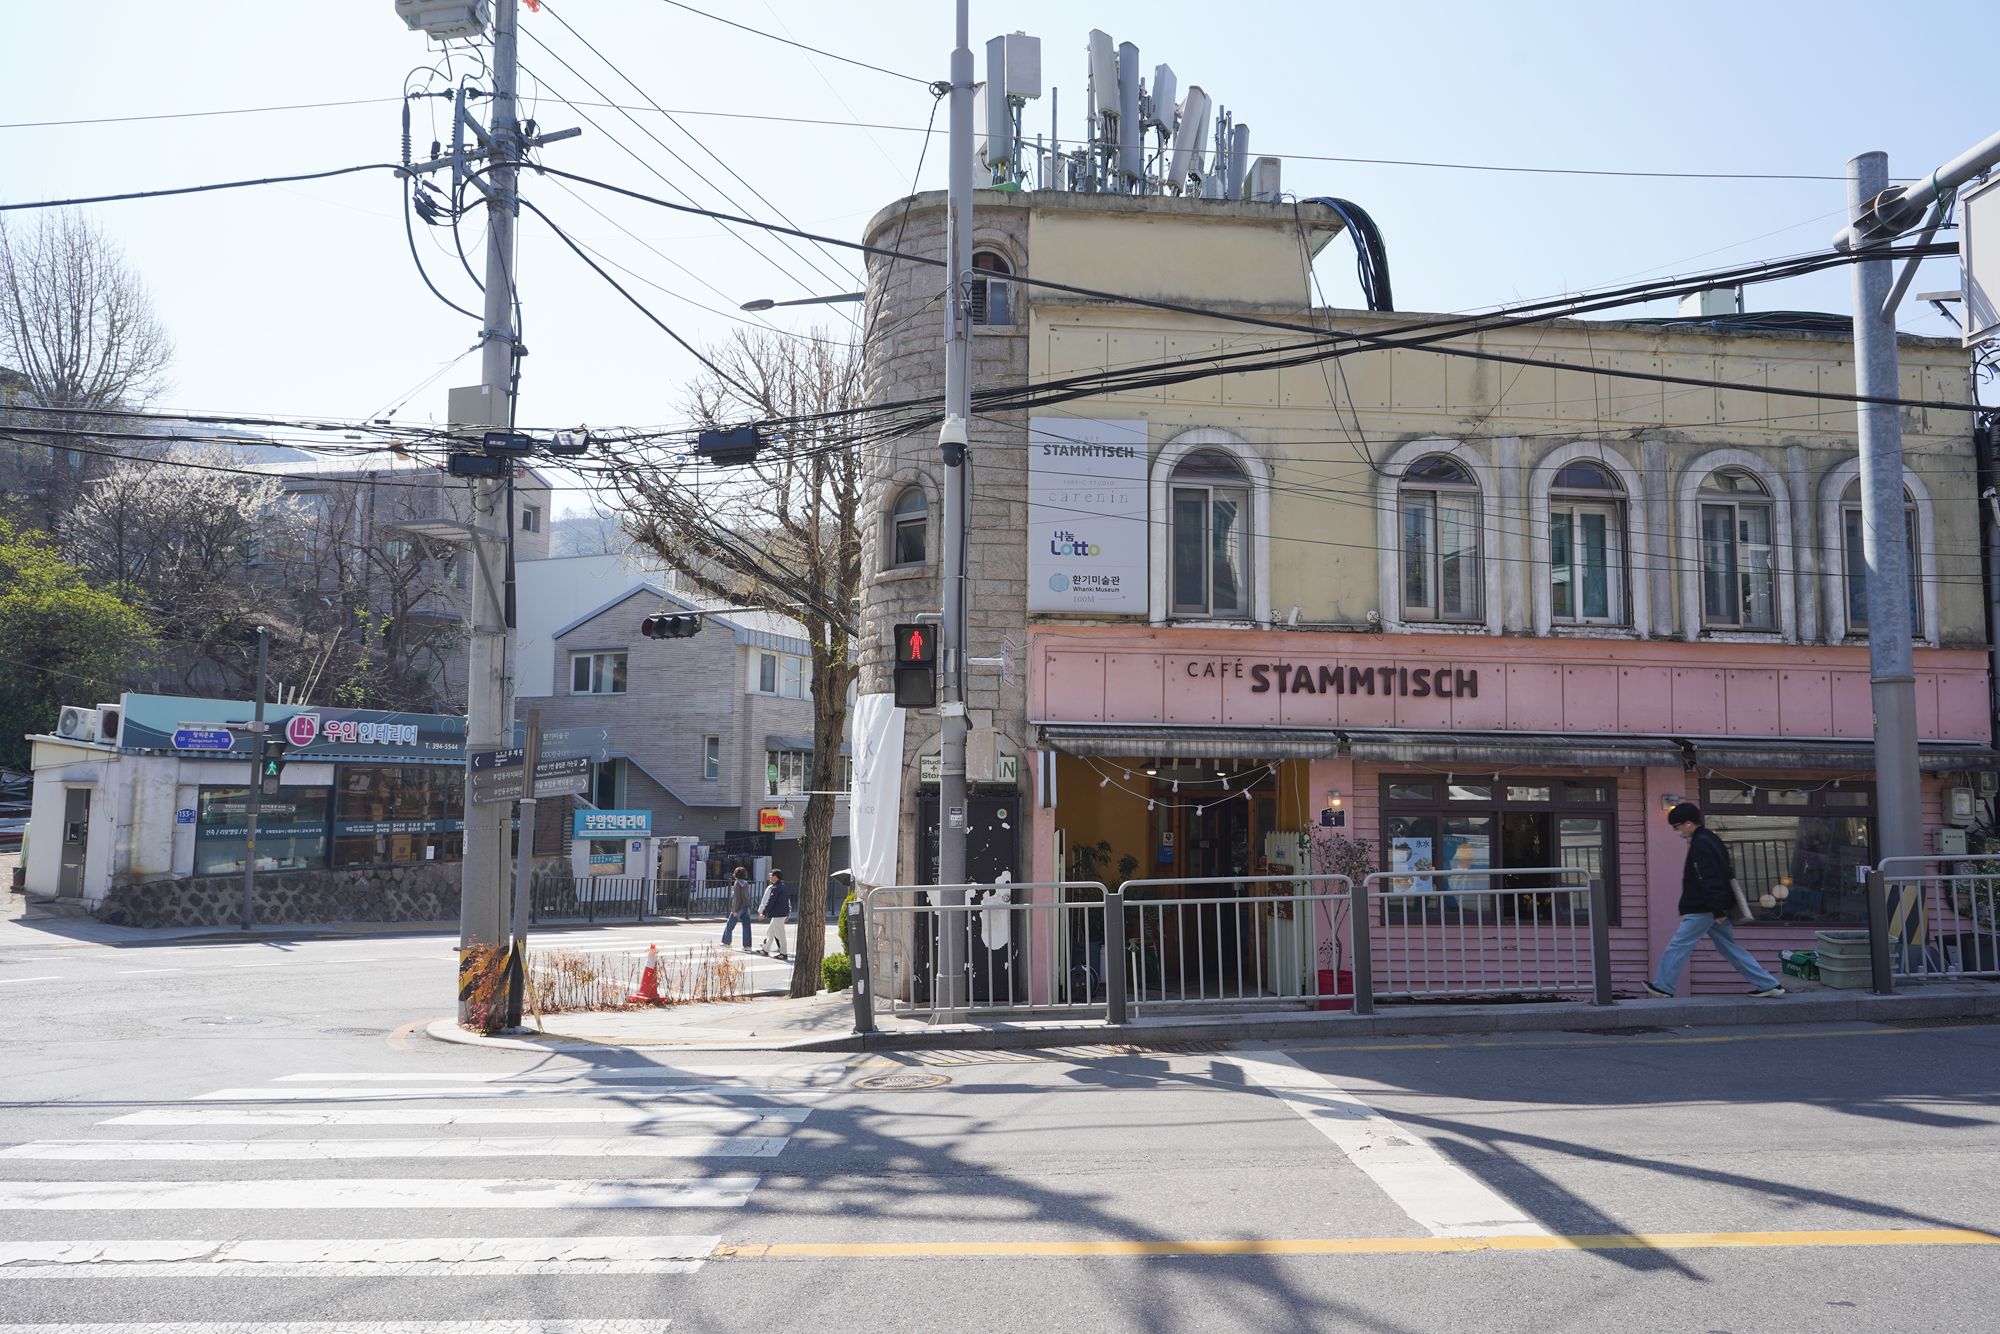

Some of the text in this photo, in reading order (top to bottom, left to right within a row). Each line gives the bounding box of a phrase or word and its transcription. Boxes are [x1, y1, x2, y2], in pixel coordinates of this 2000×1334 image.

[1043, 444, 1134, 458] STAMMTISCH
[1048, 489, 1129, 504] carenin
[1054, 531, 1075, 542] 나눔
[1051, 541, 1101, 557] Lotto
[1072, 574, 1120, 586] 환기미술관
[1095, 586, 1120, 594] Museum
[1187, 658, 1478, 698] CAFÉ STAMMTISCH
[323, 720, 417, 746] 우인 인테리어
[585, 814, 646, 829] 부암인테리어
